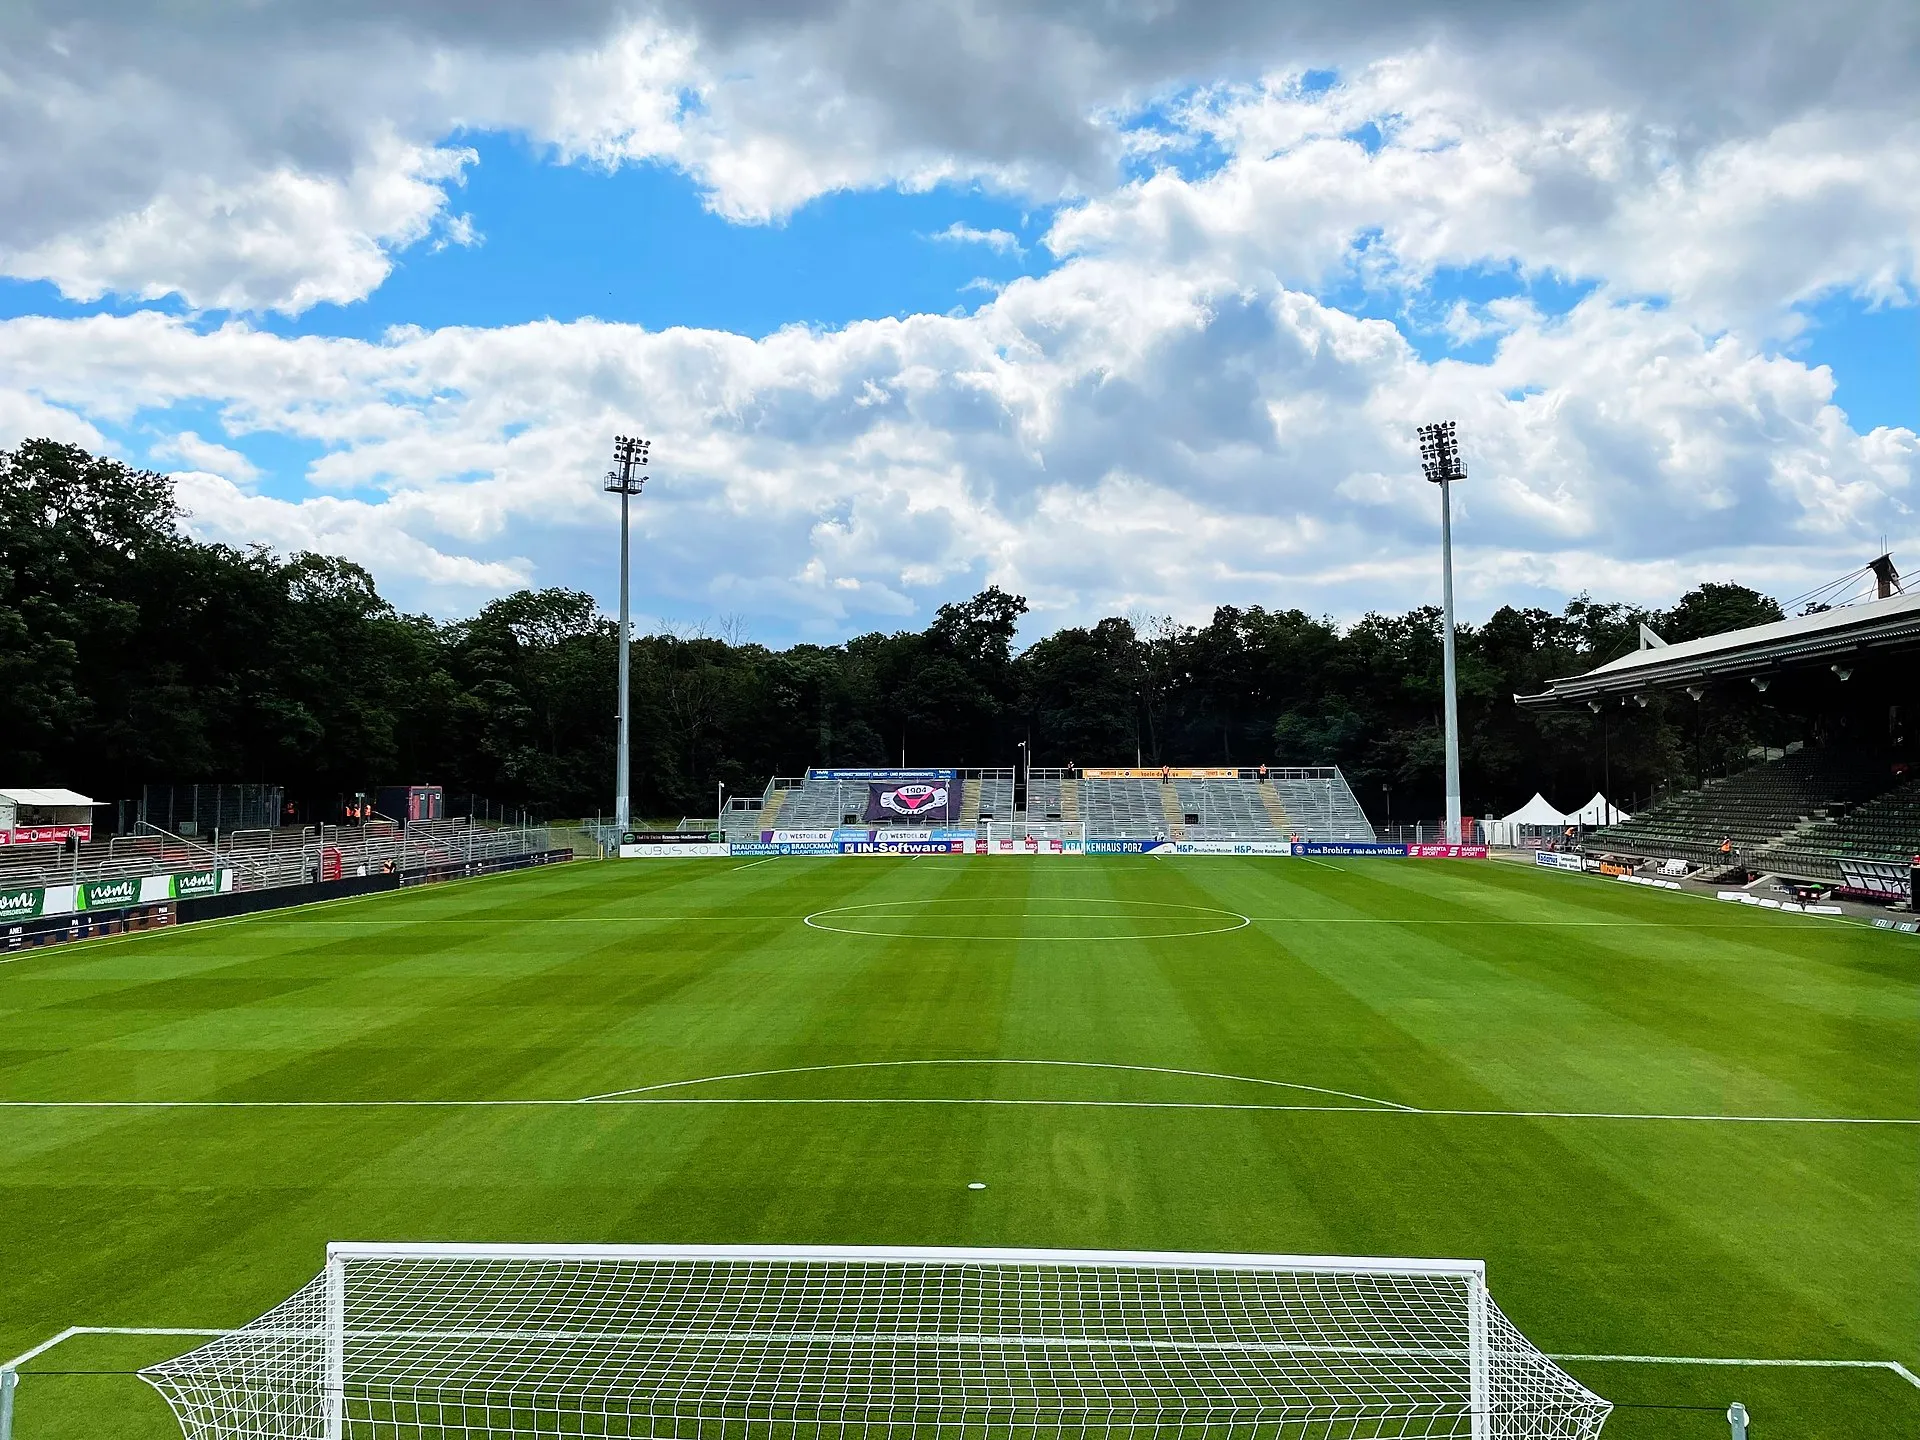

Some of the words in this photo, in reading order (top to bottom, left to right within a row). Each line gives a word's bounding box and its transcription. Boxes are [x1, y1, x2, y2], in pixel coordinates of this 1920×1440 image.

[857, 842, 947, 853] IN-Software
[1122, 842, 1143, 853] PORZ
[1176, 844, 1194, 853] H&P
[1234, 845, 1252, 854] H&P
[179, 873, 215, 888] nomi
[90, 881, 136, 900] nomi
[0, 892, 37, 910] omi
